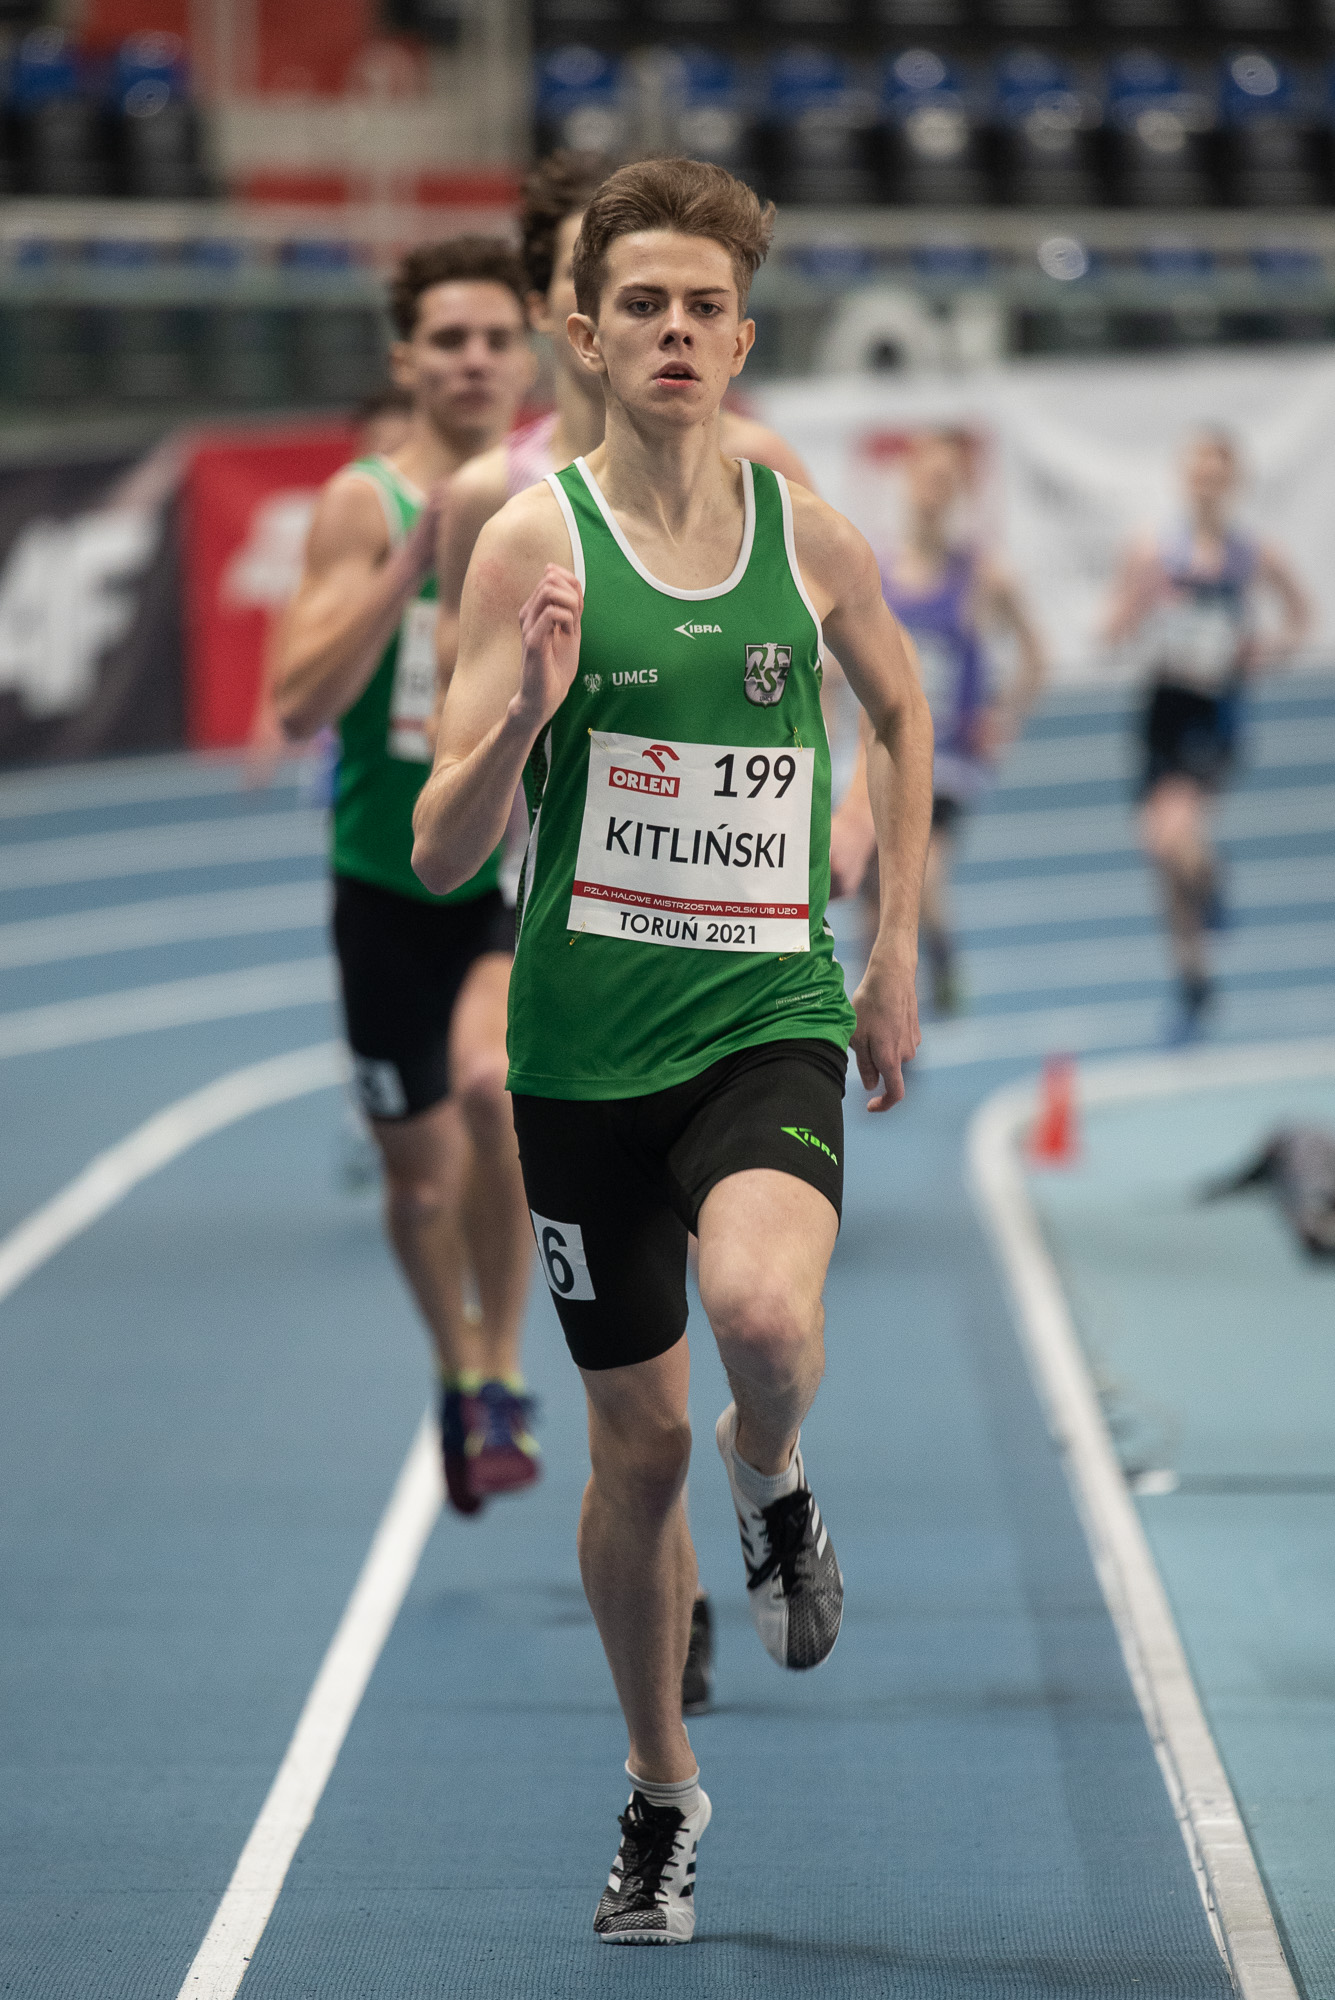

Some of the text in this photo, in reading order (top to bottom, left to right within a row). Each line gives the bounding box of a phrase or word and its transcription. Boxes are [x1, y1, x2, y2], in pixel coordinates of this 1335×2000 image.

[612, 668, 658, 686] UMCS
[612, 770, 676, 795] ORLEN
[714, 753, 797, 799] 199
[605, 816, 786, 869] KITLIŃSKI
[583, 885, 798, 916] PZLA HALOWE MISTRZOSTWA POLSKI U18 U20
[620, 911, 756, 945] TORUŃ 2021
[542, 1226, 575, 1294] 6
